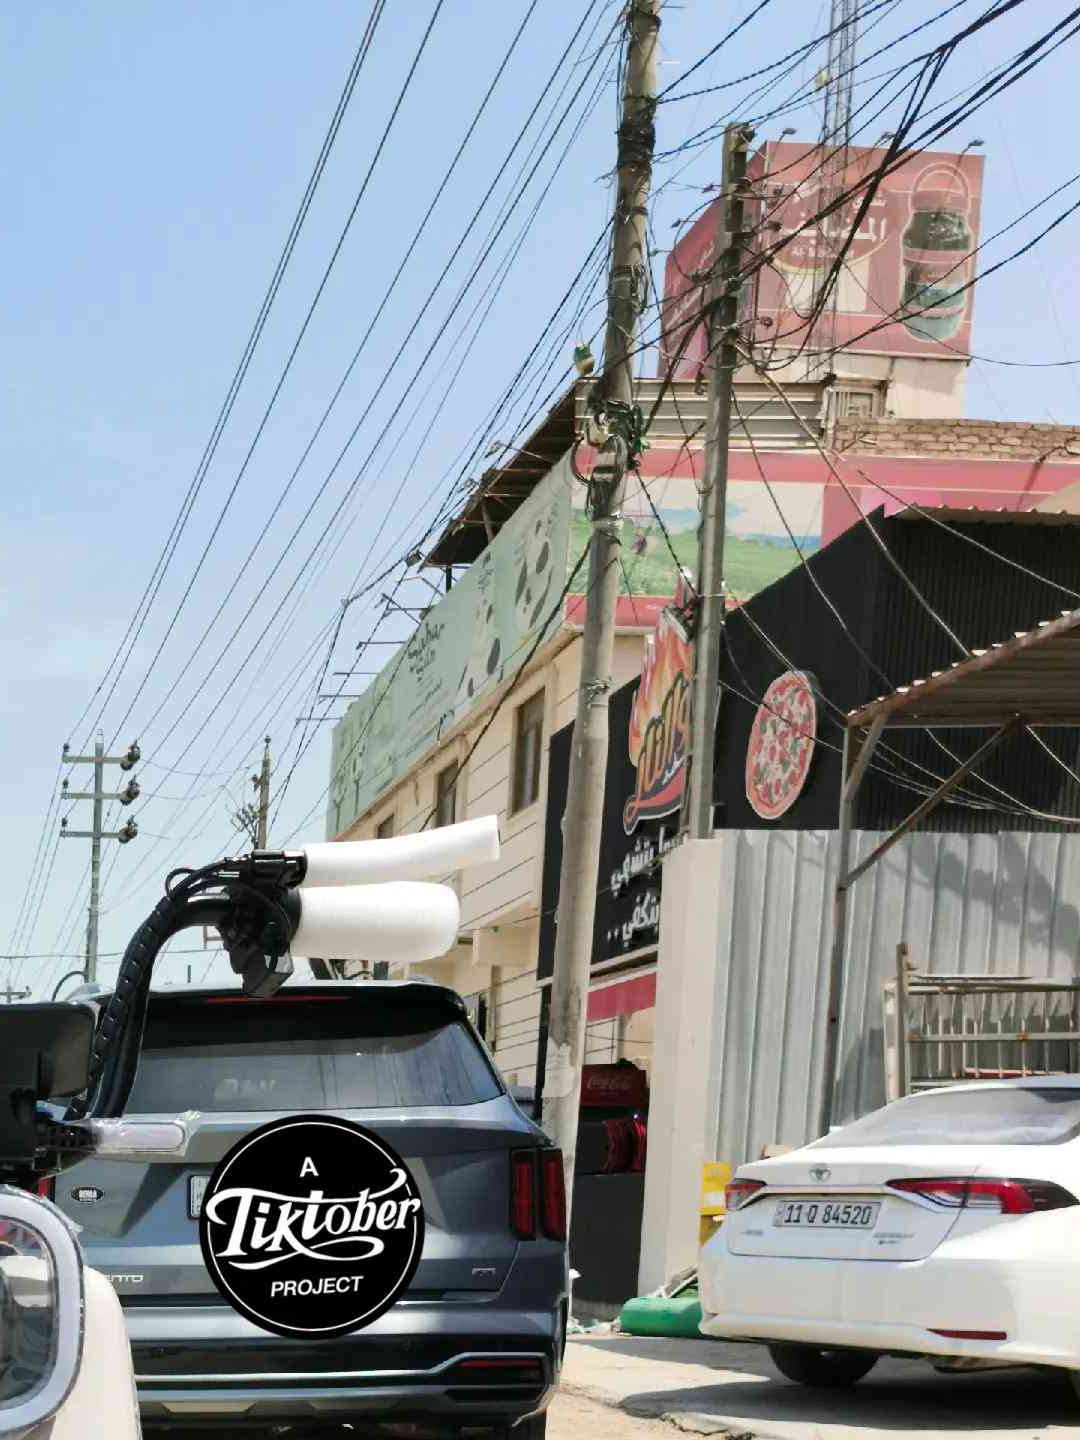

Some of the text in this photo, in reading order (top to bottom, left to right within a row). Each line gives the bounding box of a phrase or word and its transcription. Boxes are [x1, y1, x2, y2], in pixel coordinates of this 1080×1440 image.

[783, 1204, 804, 1224] 11
[807, 1204, 820, 1225] Q
[822, 1204, 873, 1226] 84520
